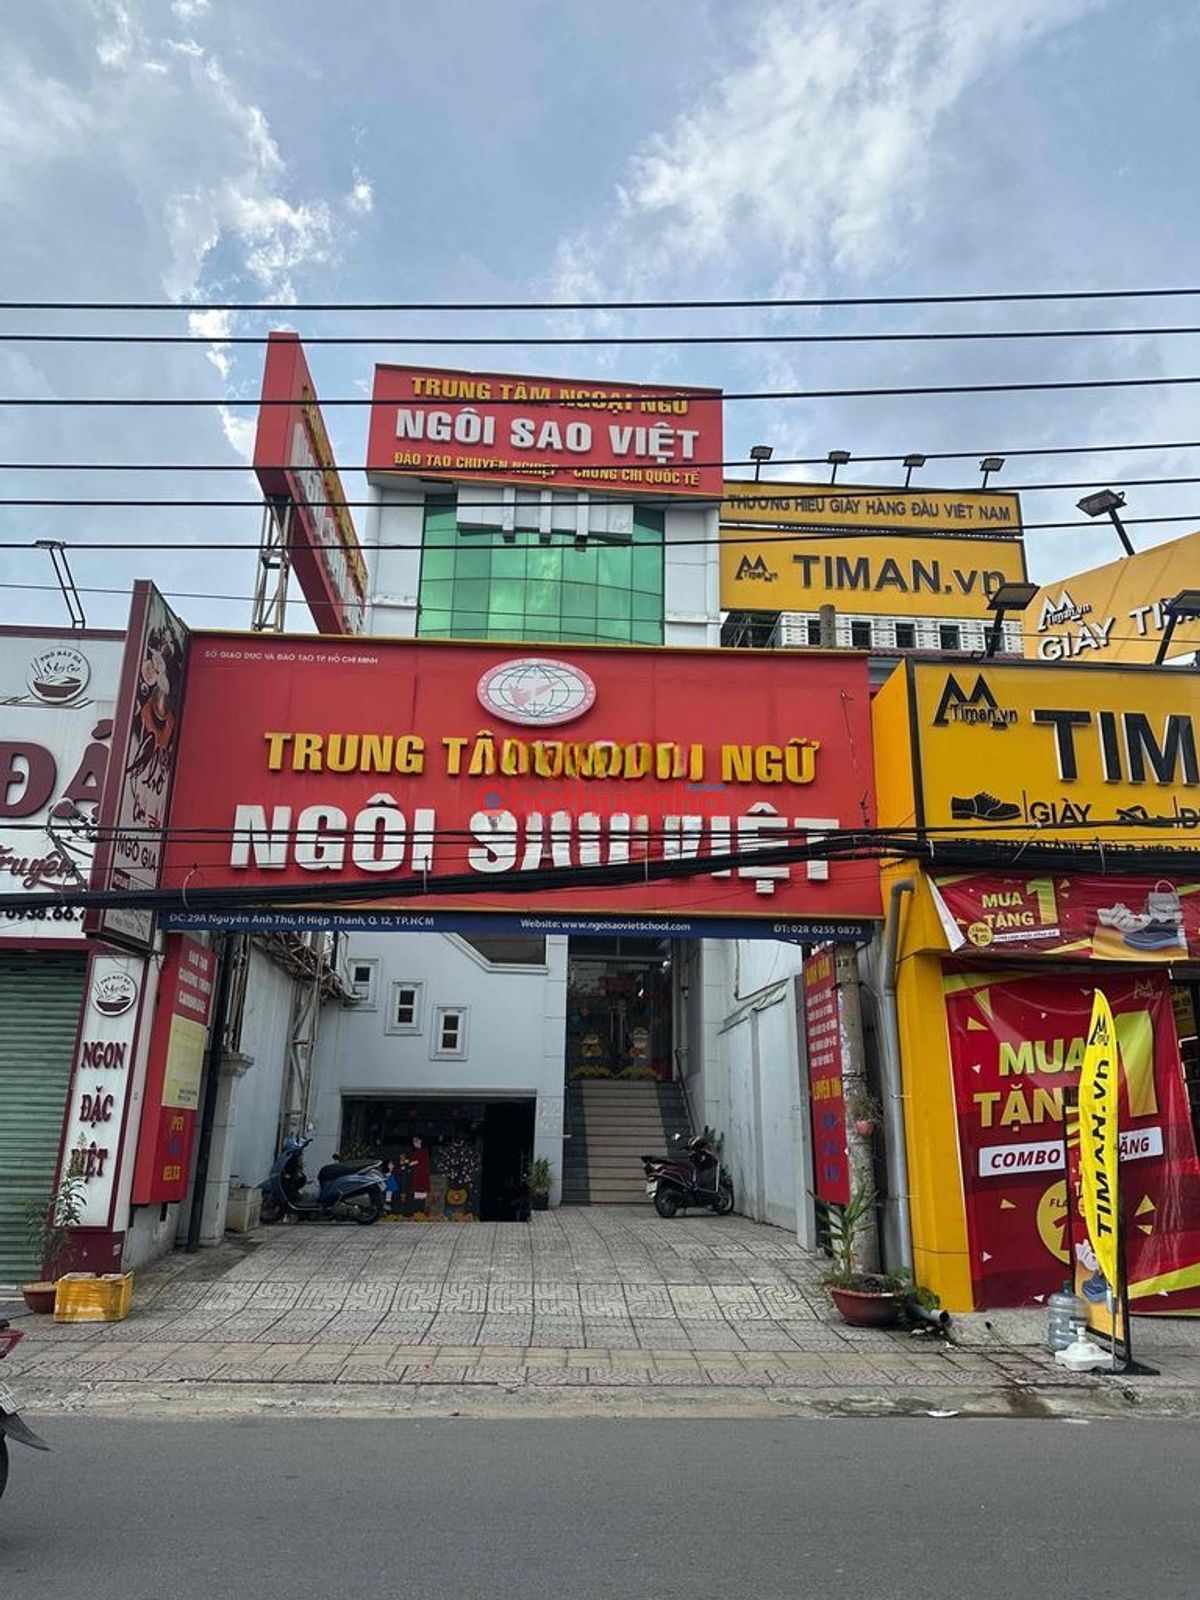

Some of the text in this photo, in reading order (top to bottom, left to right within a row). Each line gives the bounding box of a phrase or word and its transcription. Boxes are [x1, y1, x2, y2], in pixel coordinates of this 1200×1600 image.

[412, 377, 491, 400] TRUNG
[500, 382, 551, 406] TÂM
[395, 407, 699, 464] NGÔI SAO VIỆT
[866, 498, 906, 516] HÀNG
[979, 506, 1011, 521] NAM
[793, 554, 1005, 595] TIMAN.vn
[1038, 618, 1115, 661] GIÀY
[264, 732, 425, 774] TRUNG
[721, 738, 820, 784] NGỮ
[1029, 798, 1092, 824] GIÀY
[230, 792, 437, 873] NGÔI
[982, 891, 1023, 909] MUA
[520, 918, 560, 929] Website:
[81, 1041, 127, 1069] NGON
[999, 1037, 1087, 1076] MUA
[79, 1085, 114, 1128] ĐẶC
[973, 1083, 1064, 1132] TẶN
[991, 1149, 1061, 1169] COMBO
